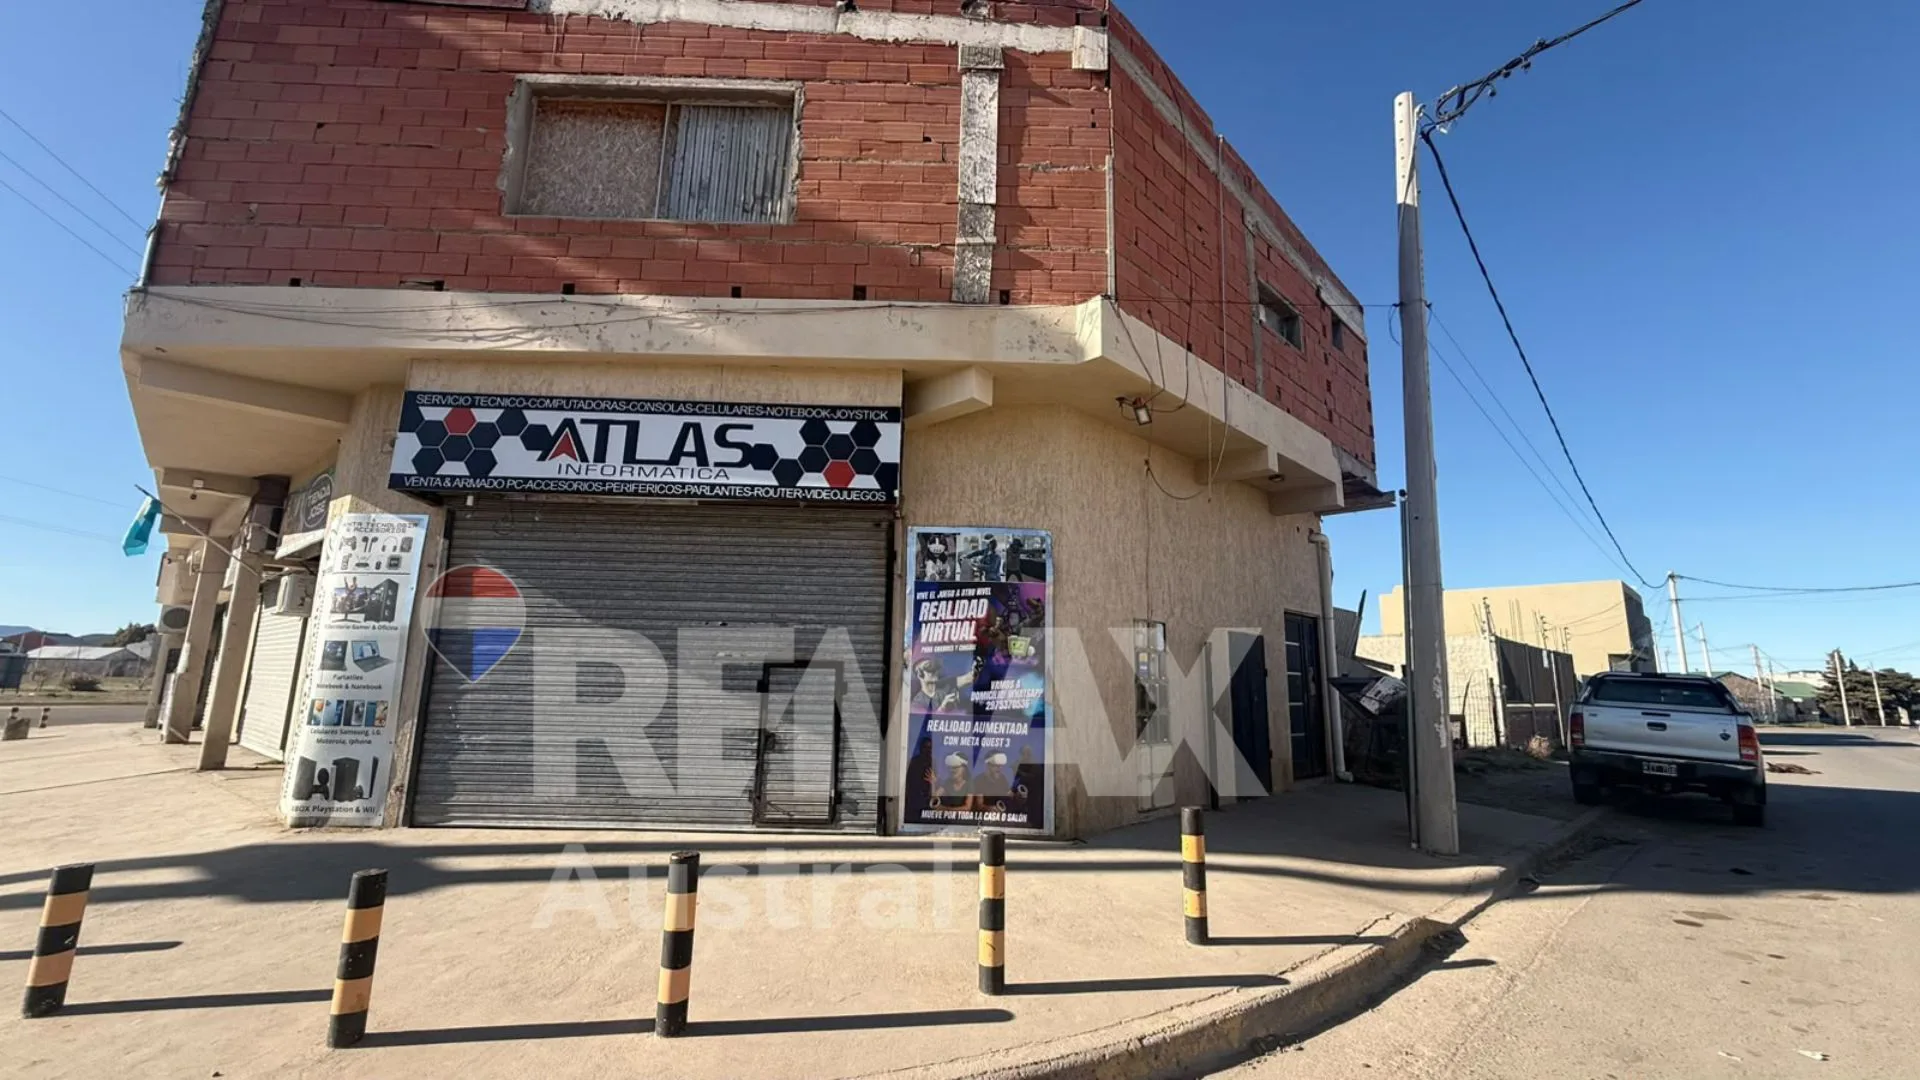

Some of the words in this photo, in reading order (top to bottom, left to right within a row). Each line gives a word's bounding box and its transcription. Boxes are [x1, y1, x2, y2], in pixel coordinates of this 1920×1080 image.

[415, 393, 472, 406] SERVICIO
[536, 417, 755, 468] ATLAS
[556, 463, 731, 481] INFORMATICA
[403, 476, 442, 488] VENTA
[451, 478, 505, 490] ARMADO
[918, 598, 989, 622] REALIDAD
[920, 620, 977, 644] VIRTUAL
[926, 719, 971, 734] REALIDAD
[972, 721, 1029, 736] AUMENTADA
[943, 735, 958, 746] CON
[959, 736, 979, 747] META
[980, 737, 1004, 748] QUEST
[1004, 738, 1011, 748] 3
[921, 809, 943, 819] MUEVE
[943, 811, 956, 820] POR
[957, 811, 974, 820] TODA
[974, 812, 983, 821] LA
[983, 812, 1000, 822] CASA
